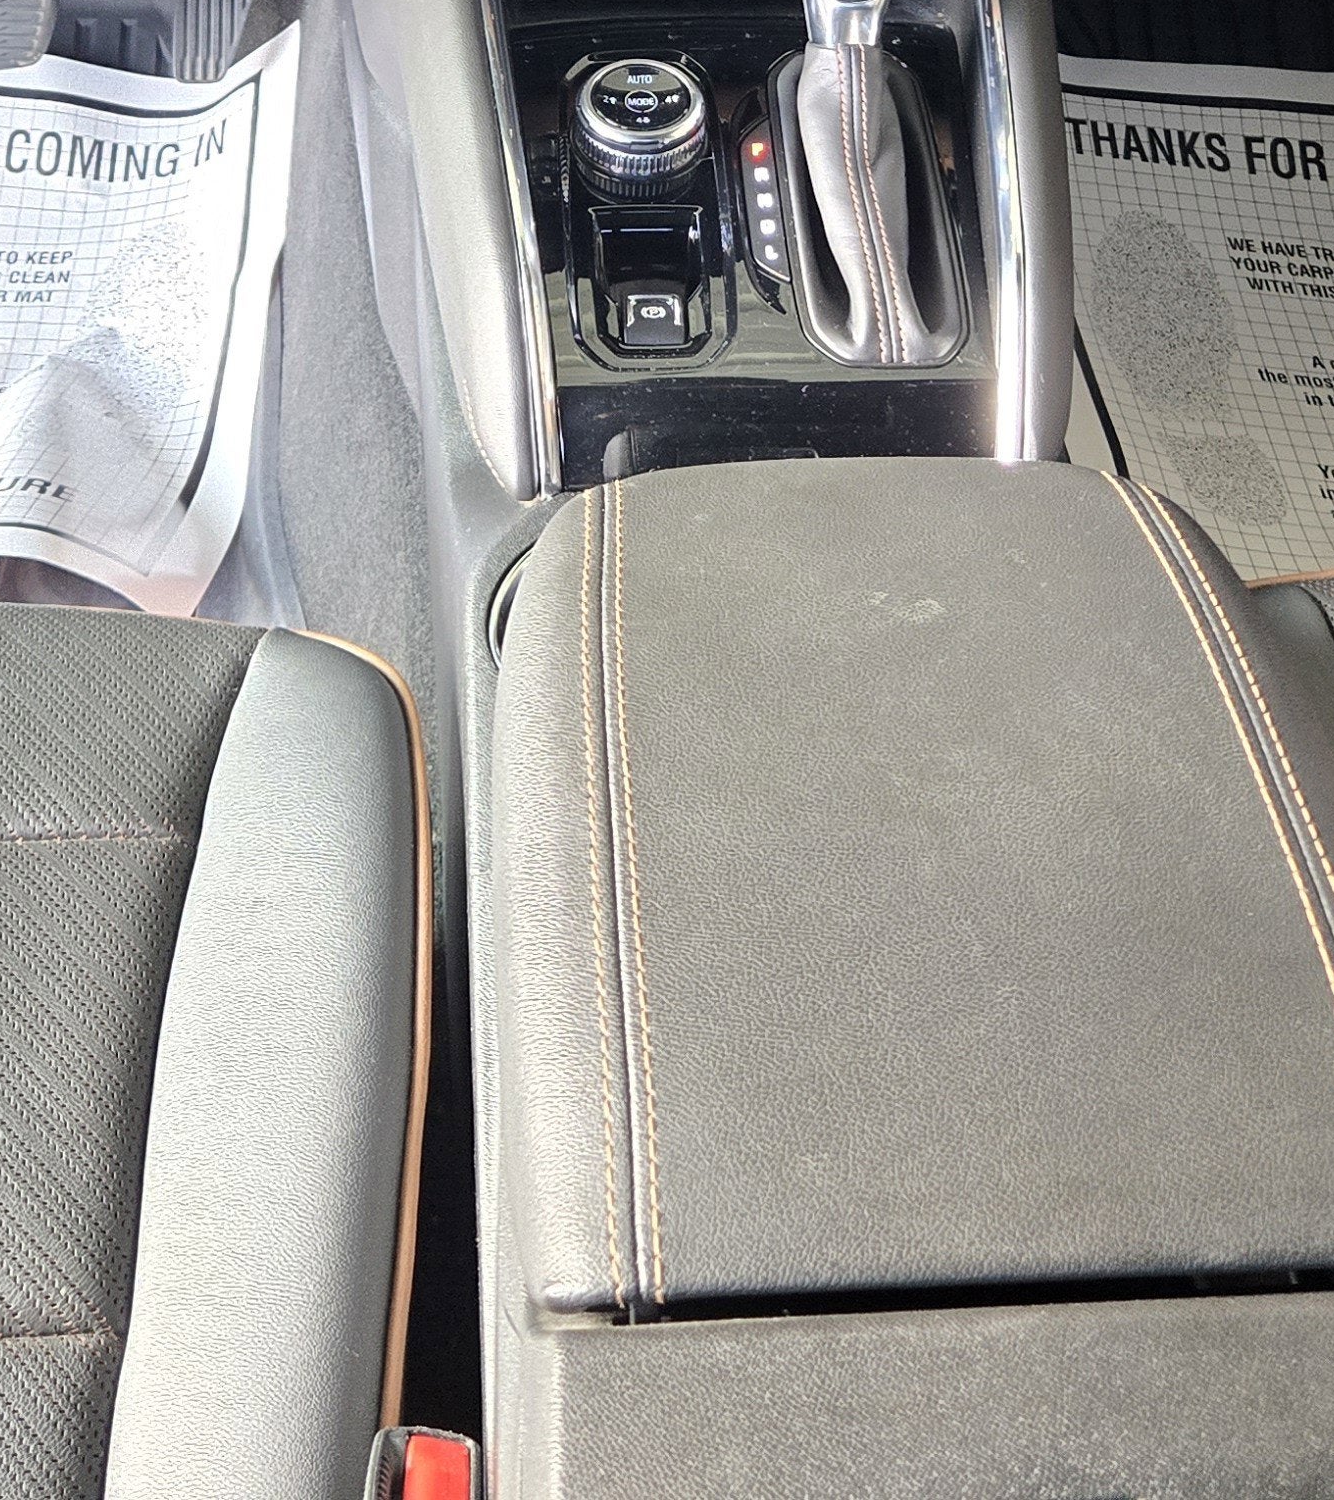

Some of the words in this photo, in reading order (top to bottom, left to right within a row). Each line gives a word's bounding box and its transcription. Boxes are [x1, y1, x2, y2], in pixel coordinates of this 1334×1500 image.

[627, 74, 653, 85] AUTO
[627, 97, 655, 106] MODE
[5, 129, 180, 183] COMING
[194, 118, 227, 167] IN
[1064, 116, 1231, 173] THANKS
[1243, 135, 1328, 182] FOR
[1227, 236, 1256, 253] WE
[1261, 240, 1308, 258] HAVE
[25, 250, 74, 265] KEEP
[1230, 256, 1282, 275] YOUR
[8, 270, 70, 284] CLEAN
[1245, 277, 1295, 294] WITH
[14, 289, 55, 303] MAT
[1312, 355, 1325, 370] A
[1258, 368, 1288, 384] the
[1304, 392, 1324, 407] in
